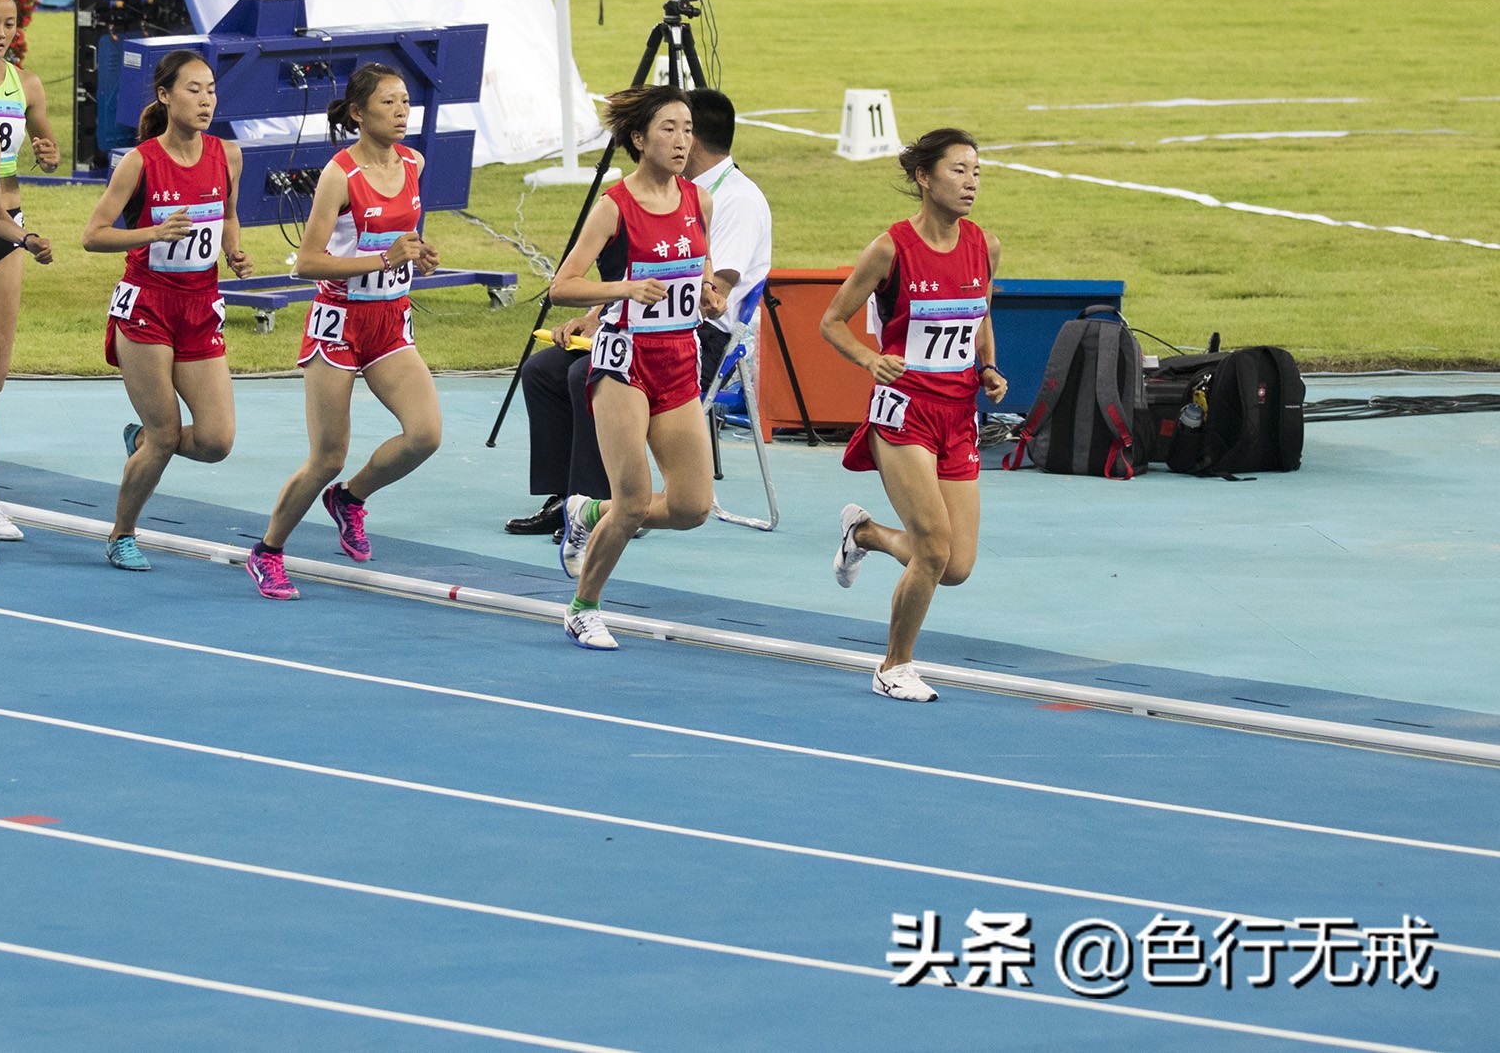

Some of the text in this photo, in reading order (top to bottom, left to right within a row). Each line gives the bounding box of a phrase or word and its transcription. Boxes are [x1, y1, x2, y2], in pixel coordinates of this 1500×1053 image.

[868, 103, 885, 138] 11
[313, 306, 341, 339] 12
[924, 325, 974, 360] 775
[876, 389, 905, 423] 17
